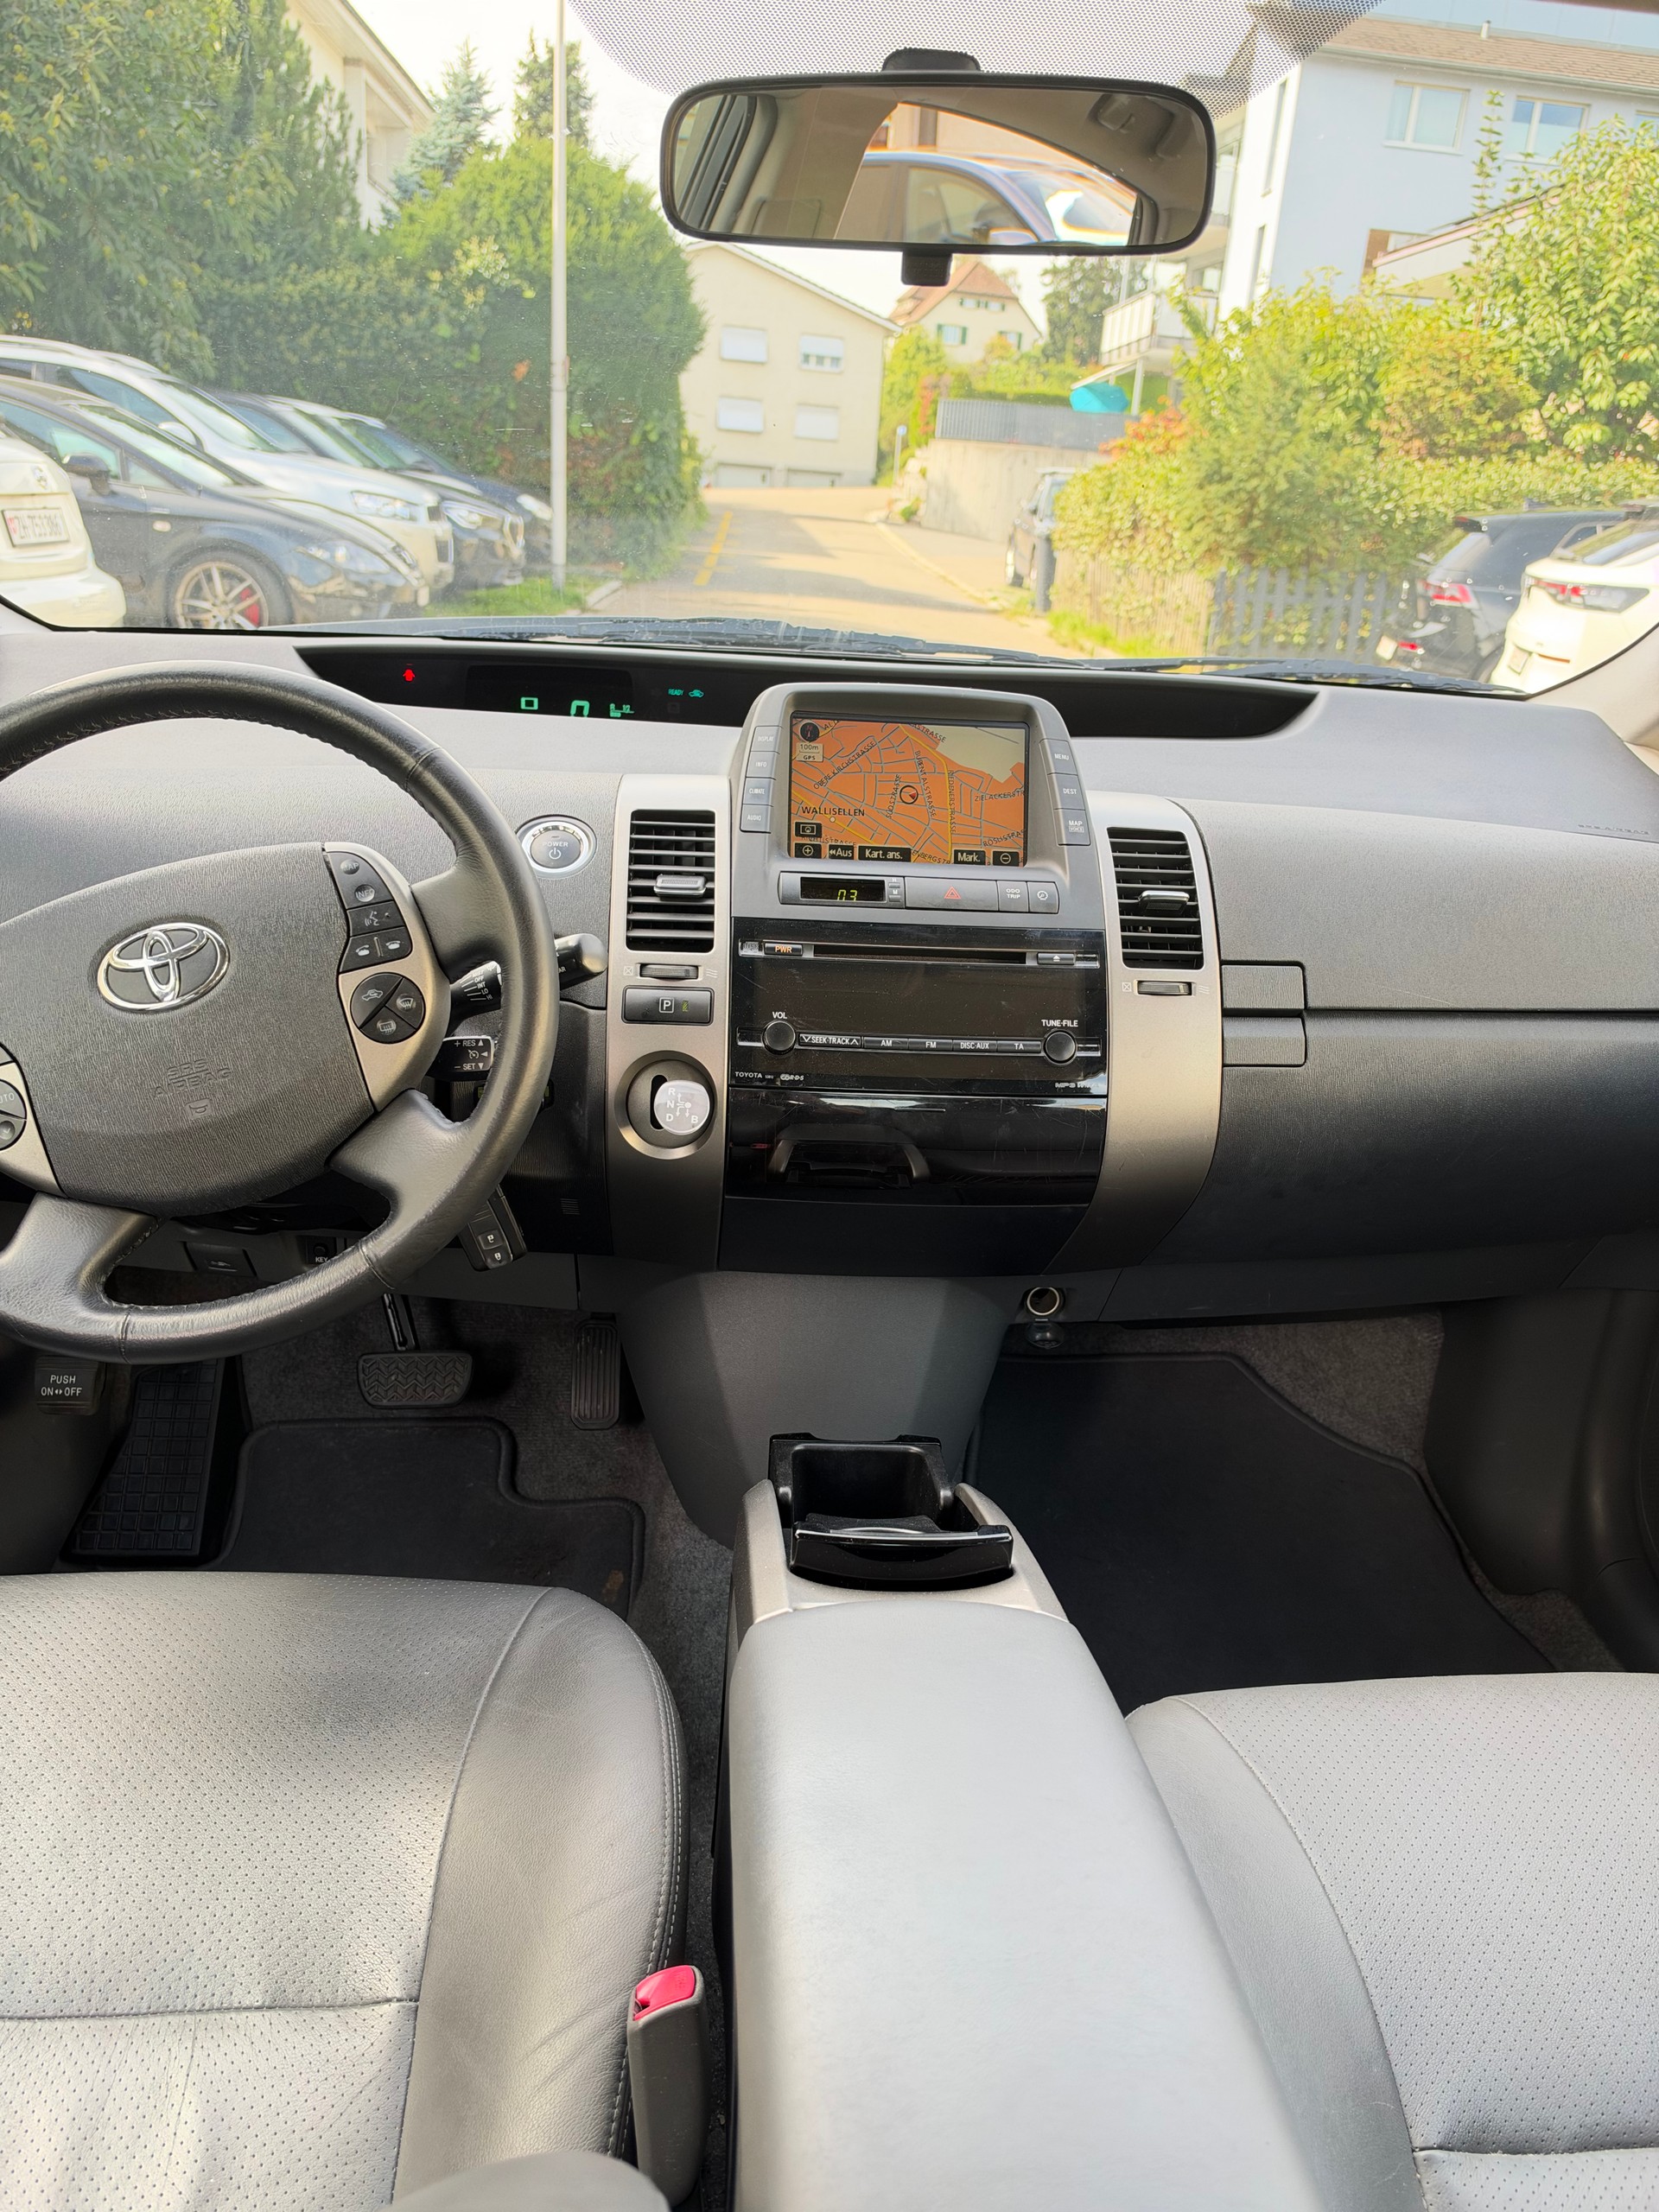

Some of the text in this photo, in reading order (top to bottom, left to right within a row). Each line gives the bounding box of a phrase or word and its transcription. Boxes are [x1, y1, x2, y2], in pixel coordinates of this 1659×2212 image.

[801, 806, 865, 817] WALLISELLEN
[836, 848, 853, 857] Aus
[865, 849, 885, 859] Kart.
[957, 852, 981, 862] Mark.
[355, 888, 375, 899] INFO
[663, 1001, 671, 1009] P
[167, 1058, 208, 1077] SRS
[156, 1067, 232, 1096] AIRBAG
[50, 1375, 76, 1384] PUSH
[41, 1387, 82, 1396] ON OFF
